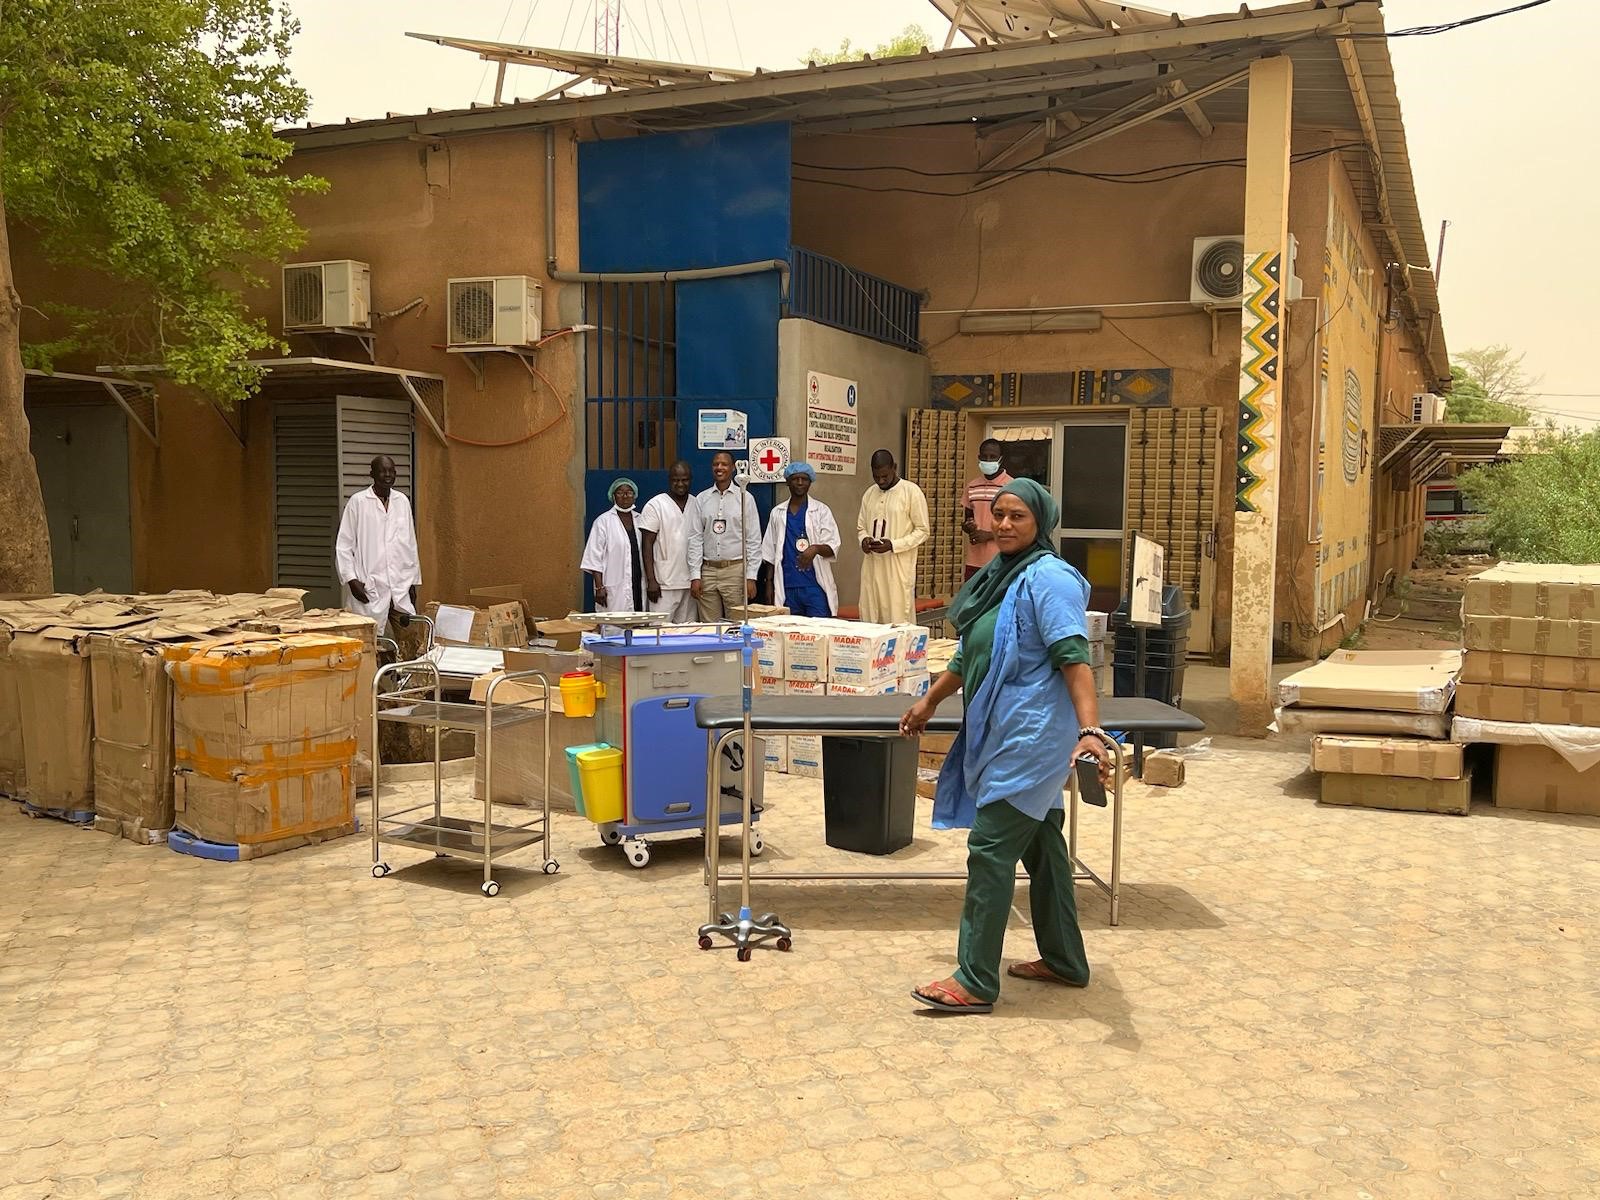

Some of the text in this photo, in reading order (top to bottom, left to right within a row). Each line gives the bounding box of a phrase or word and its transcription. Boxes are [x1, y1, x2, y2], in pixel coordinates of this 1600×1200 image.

[789, 634, 816, 642] MADAR
[789, 681, 815, 690] MADAR
[831, 685, 857, 694] MADAR
